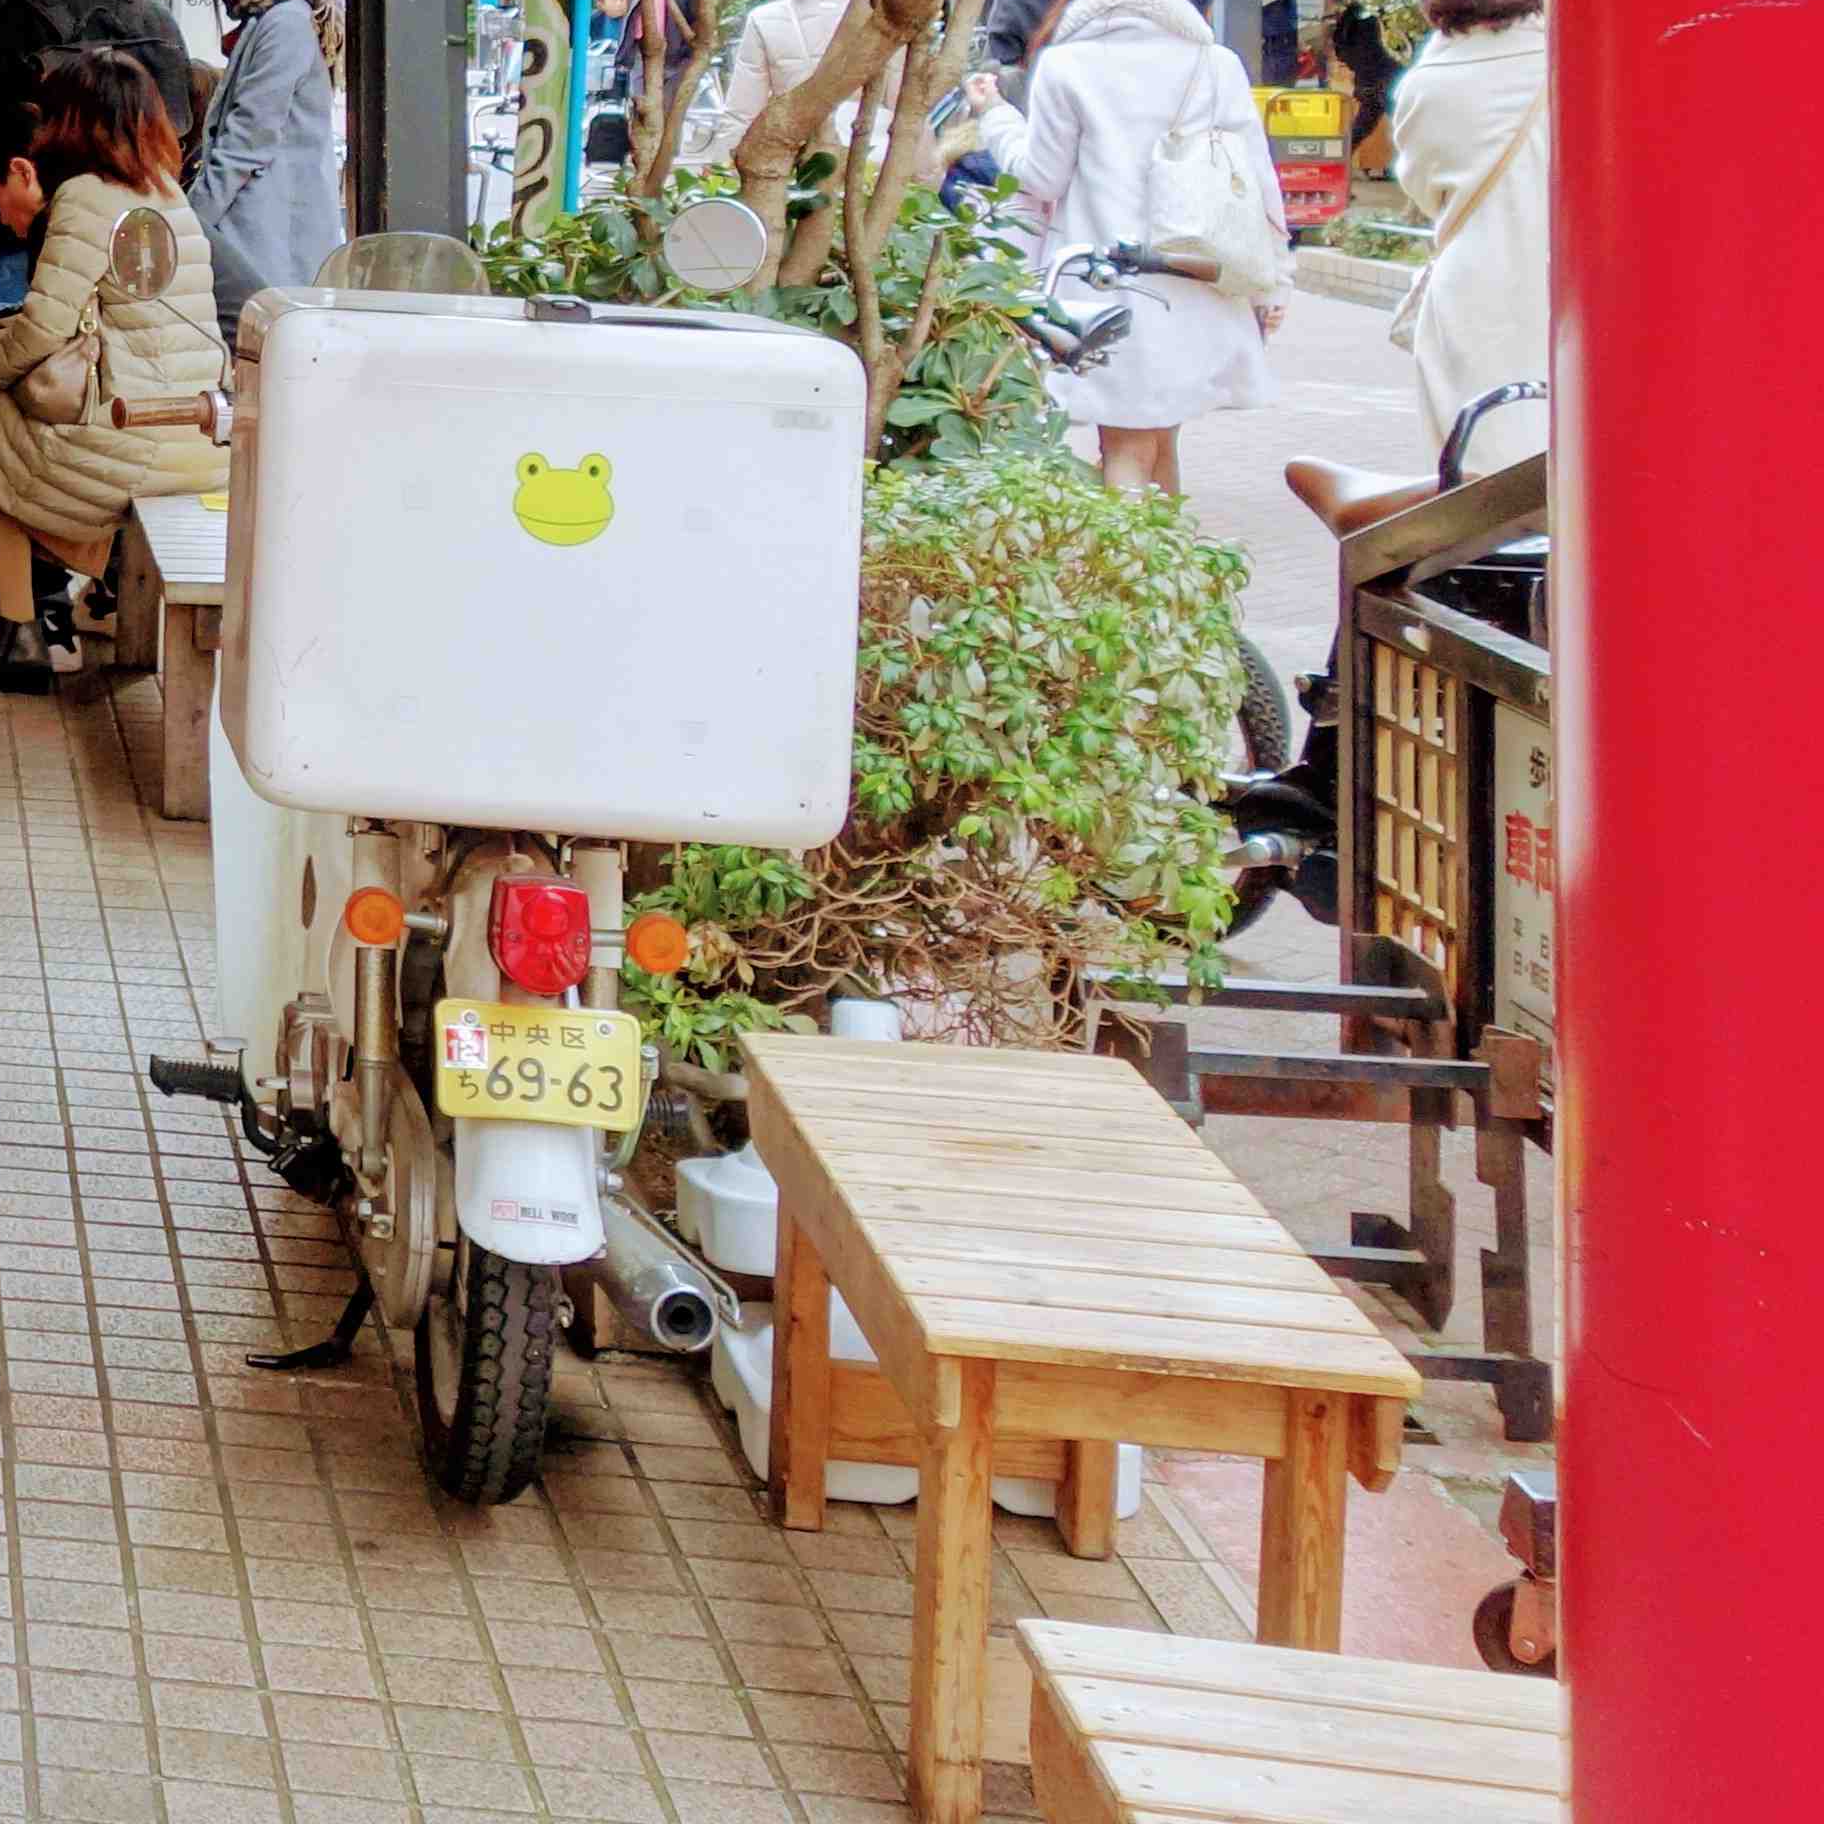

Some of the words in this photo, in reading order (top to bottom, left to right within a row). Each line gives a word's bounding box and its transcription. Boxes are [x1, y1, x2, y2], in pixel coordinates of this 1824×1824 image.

[489, 1021, 587, 1050] 中央区
[485, 1056, 624, 1113] 69-63
